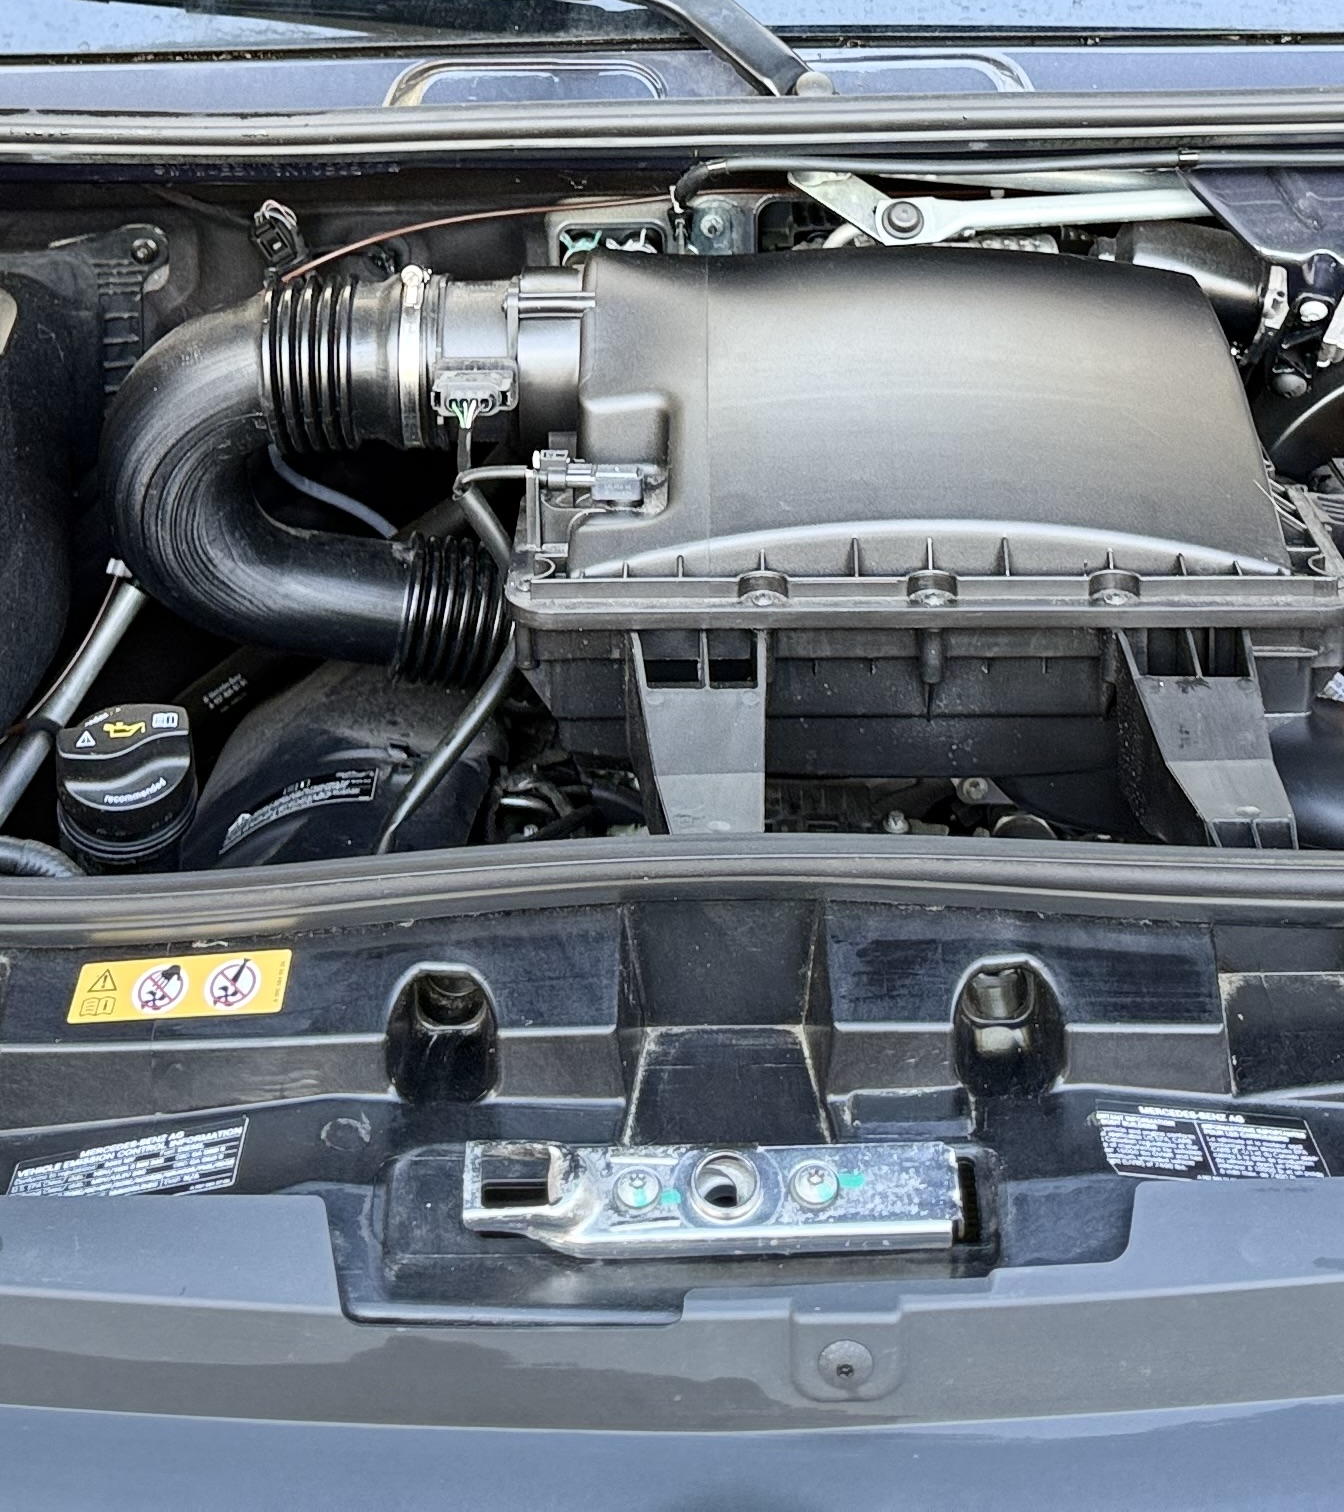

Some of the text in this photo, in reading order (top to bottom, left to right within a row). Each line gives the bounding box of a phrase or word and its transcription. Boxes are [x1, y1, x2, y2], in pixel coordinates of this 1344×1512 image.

[103, 776, 167, 804] recommended
[1138, 1105, 1227, 1122] MERCEDES-BENZ
[17, 1161, 63, 1178] VEHICLE
[62, 1151, 116, 1169] EMISSION
[116, 1143, 167, 1159] CONTROL
[168, 1126, 244, 1148] INFORMATION
[79, 1130, 186, 1159] MERCEDES-BENZ AG
